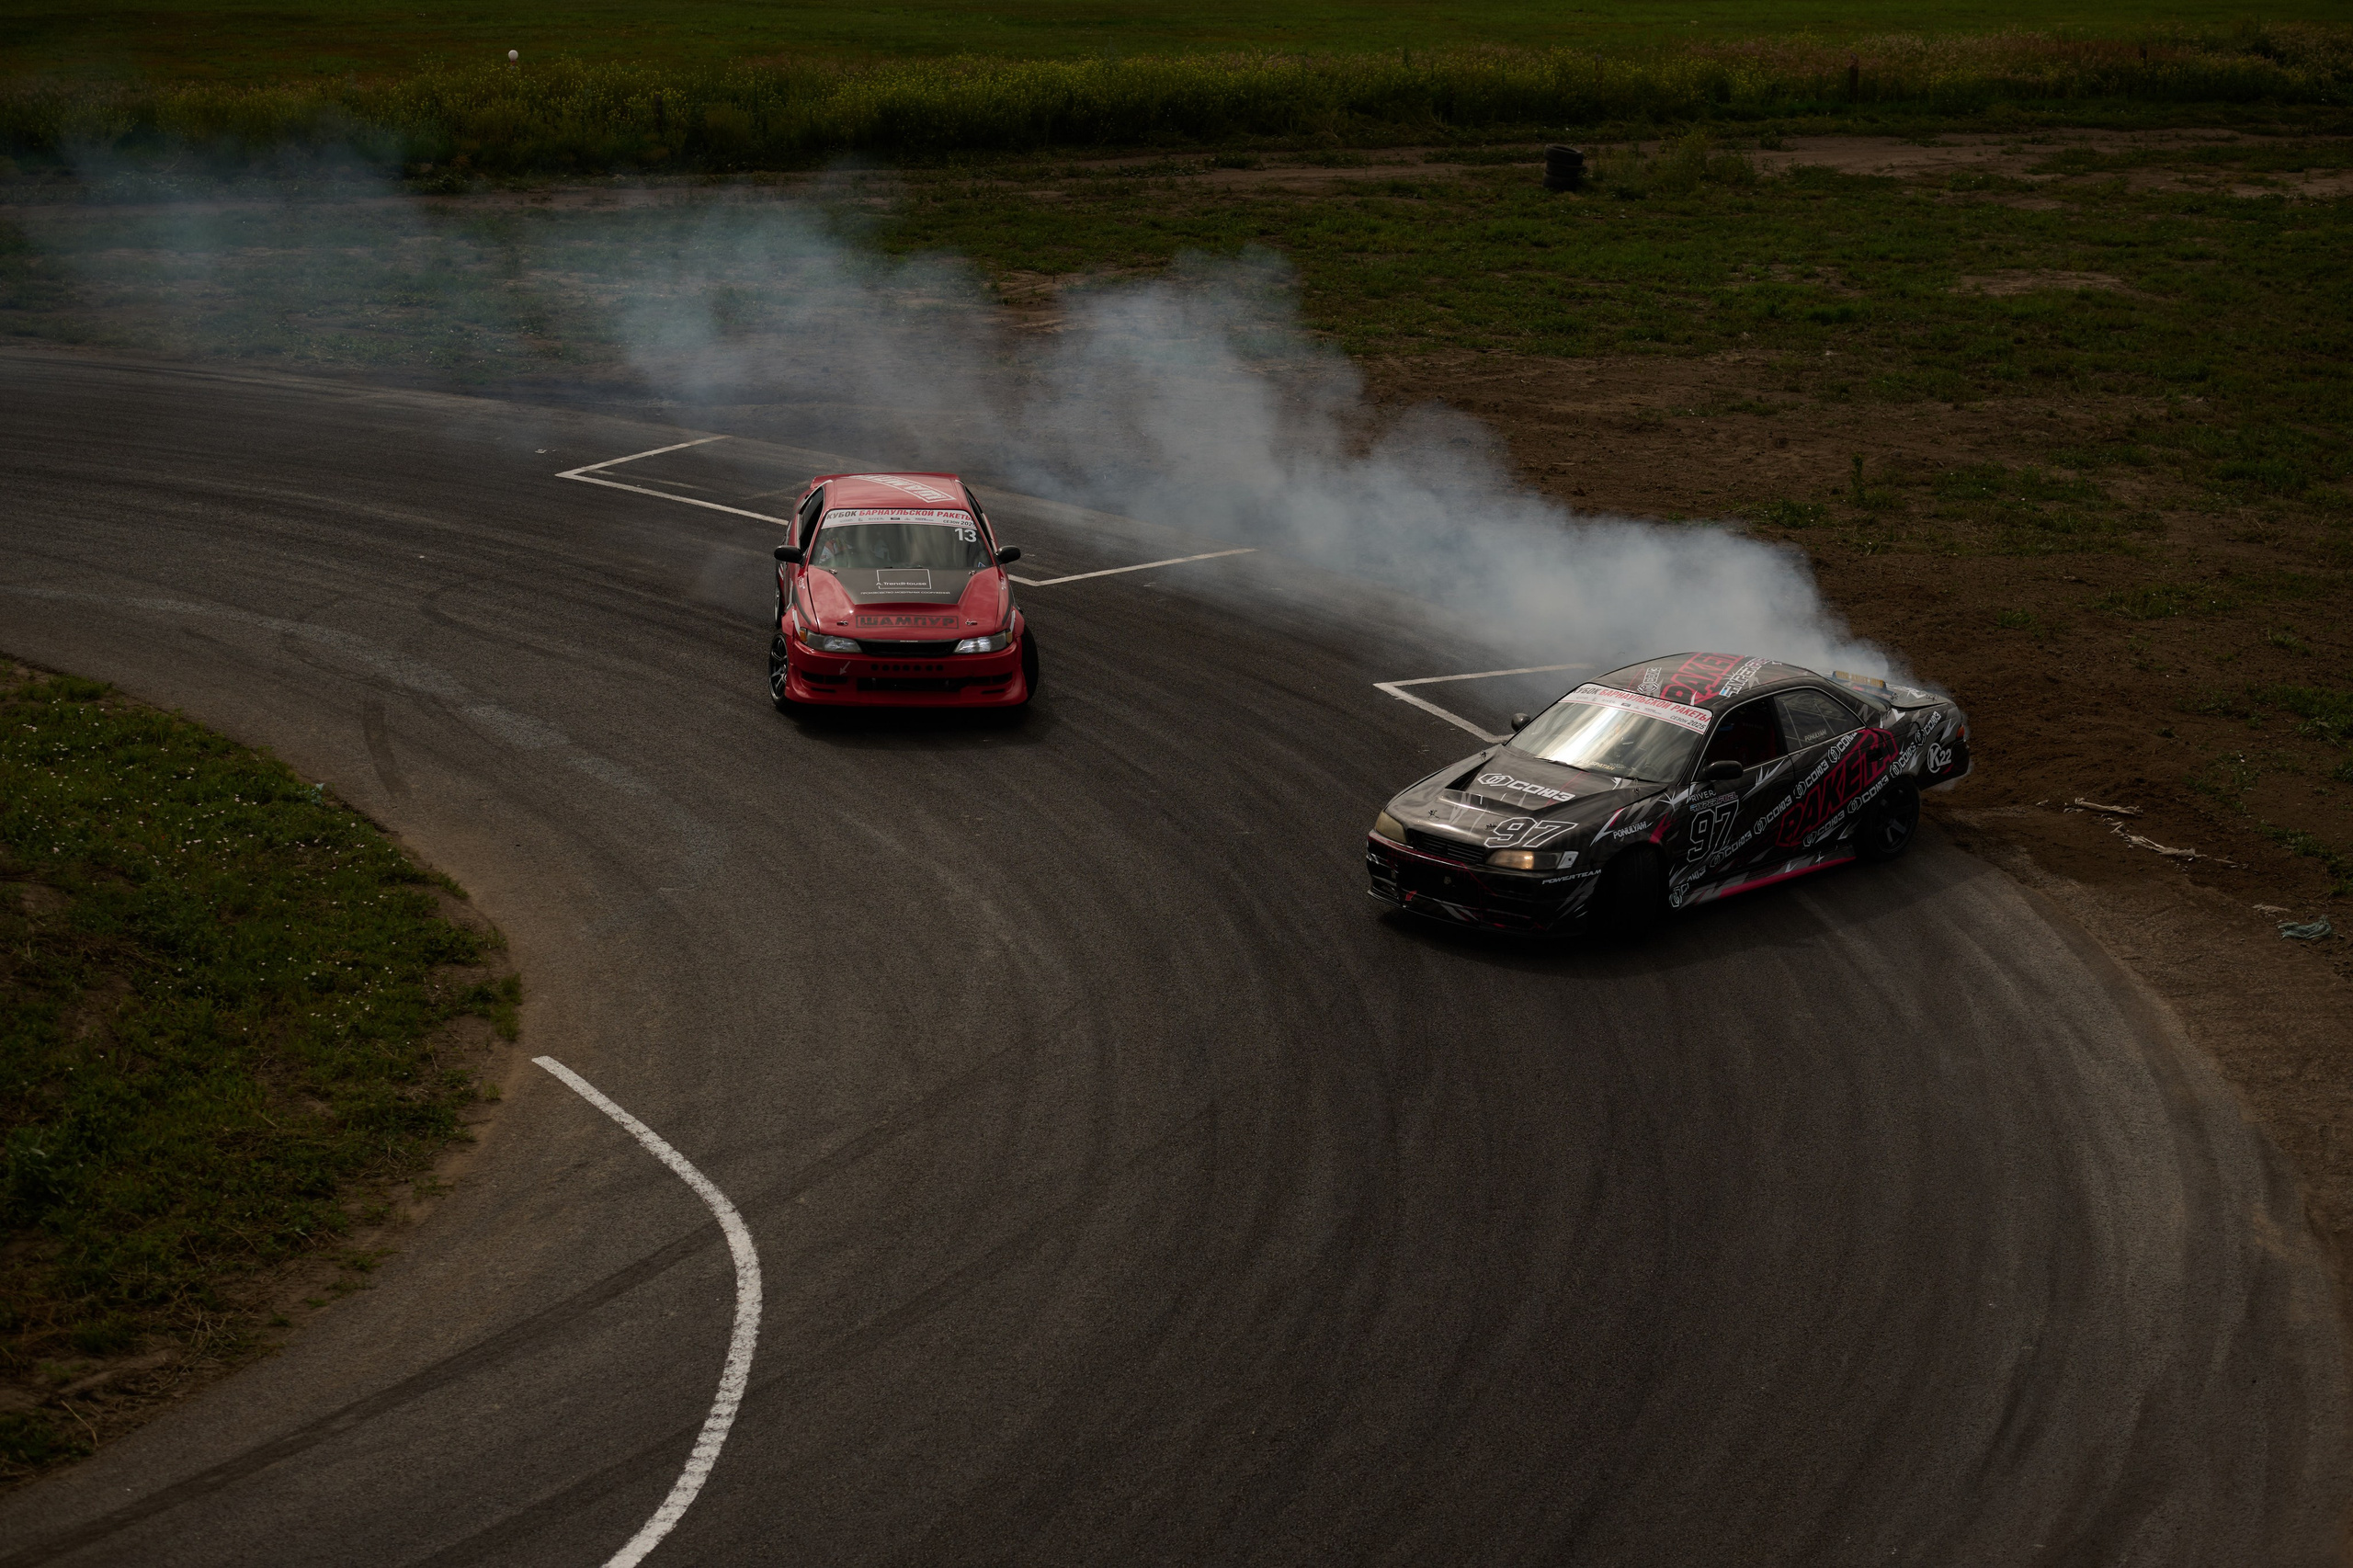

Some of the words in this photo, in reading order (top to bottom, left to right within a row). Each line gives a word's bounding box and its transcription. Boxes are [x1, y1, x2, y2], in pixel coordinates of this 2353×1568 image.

[826, 511, 857, 520] КУБОК
[954, 528, 977, 543] 13
[860, 617, 954, 627] ШАМПУР
[1573, 687, 1600, 696] КУБОК
[1599, 688, 1672, 709] БАРНАУЛЬСКОЙ
[1670, 704, 1711, 722] РАКЕТЫ
[1670, 715, 1688, 723] СЕЗОН
[1687, 720, 1706, 730] 2025
[1923, 710, 1941, 735] СОЮЗ
[1899, 742, 1918, 768] СОЮЗ
[1928, 744, 1951, 769] K22
[1804, 759, 1829, 788] СОЮЗ
[1507, 779, 1575, 802] СОЮЗ
[1691, 790, 1716, 802] RIVER
[1861, 775, 1889, 803] СОЮЗ
[1766, 795, 1792, 824] СОЮЗ
[1483, 817, 1579, 848] 97
[1613, 821, 1653, 840] PONULYAM
[1687, 799, 1740, 863] 97
[1816, 810, 1846, 836] СОЮЗ
[1723, 830, 1753, 858] СОЮЗ
